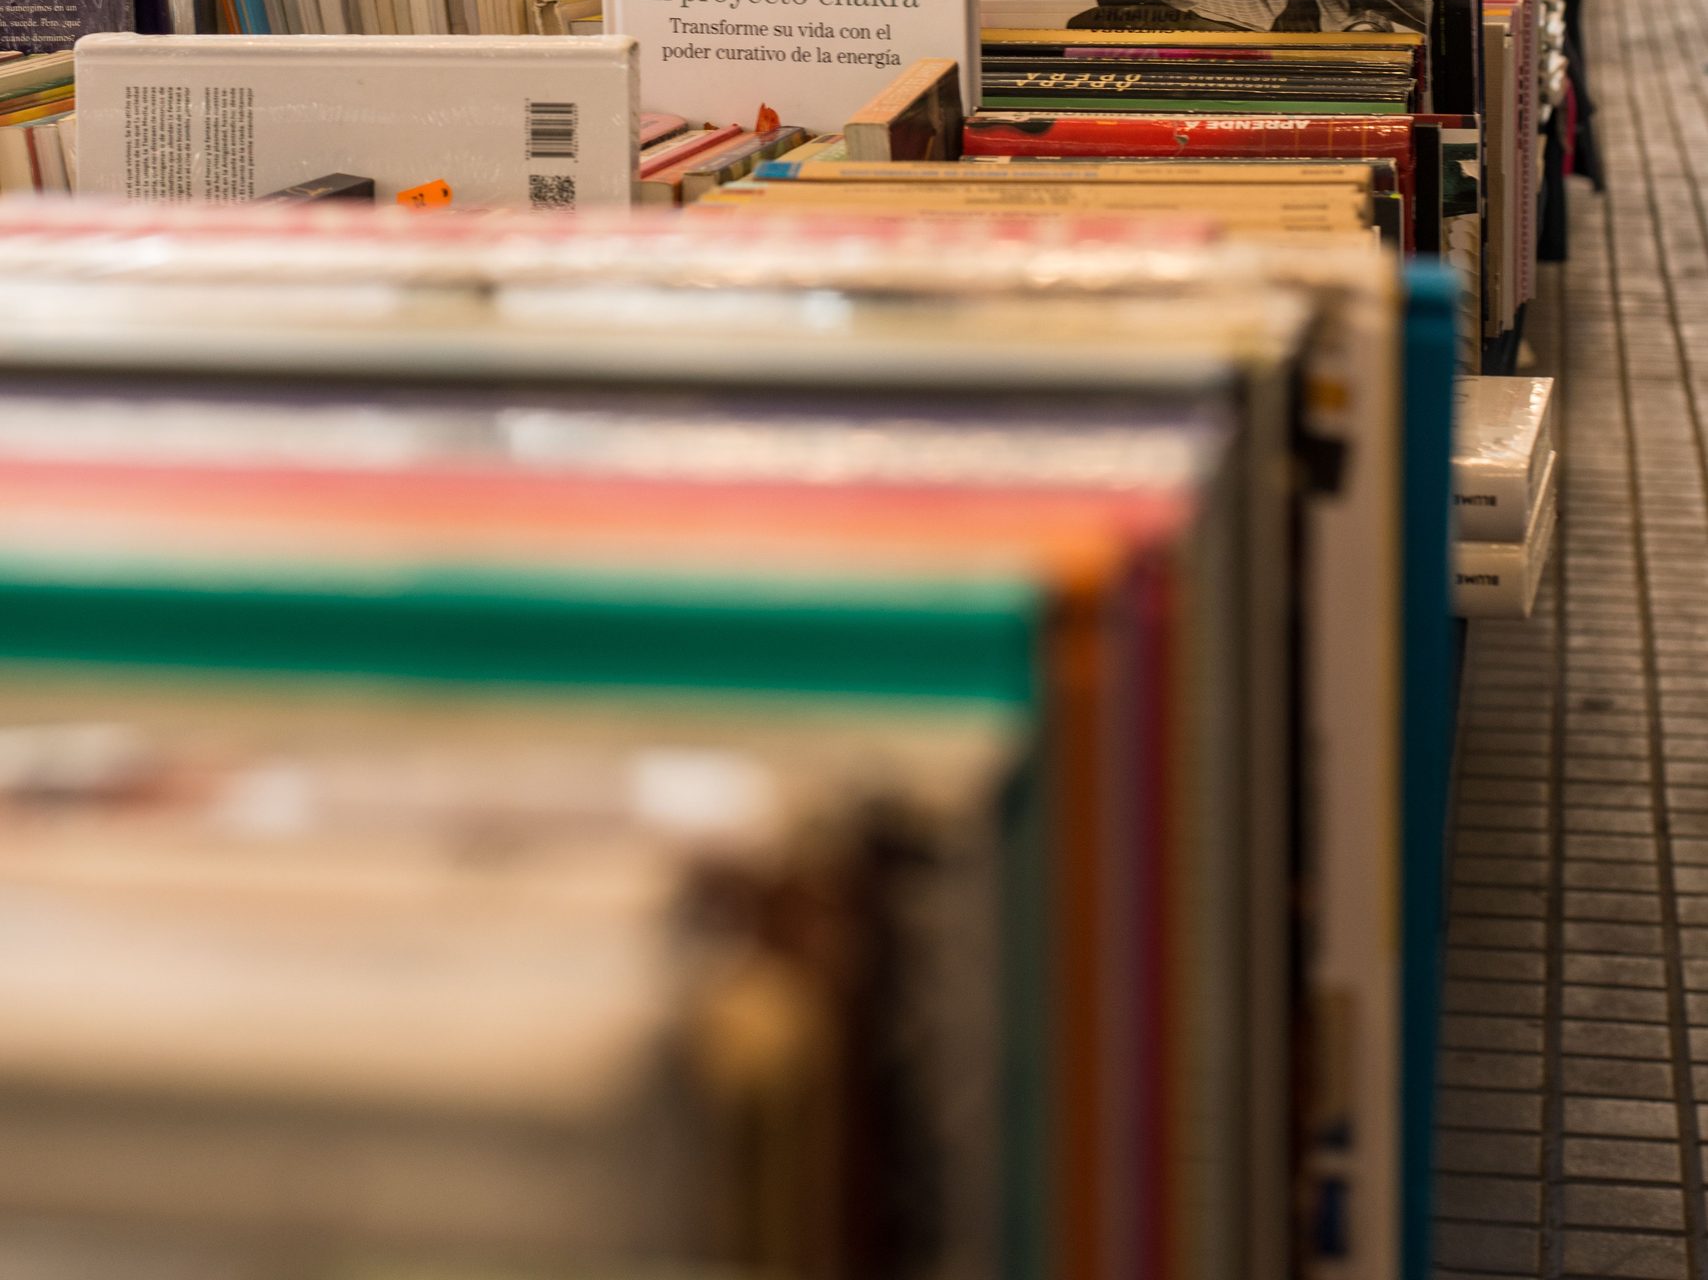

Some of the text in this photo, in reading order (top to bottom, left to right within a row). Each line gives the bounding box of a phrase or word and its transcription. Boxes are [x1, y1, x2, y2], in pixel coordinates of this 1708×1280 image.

[669, 18, 891, 41] Transforme su vida con el
[662, 43, 901, 69] poder curativo de la energía
[1206, 120, 1311, 130] APRENDE
[1454, 494, 1497, 507] BLUME
[1455, 574, 1499, 586] BLUME
